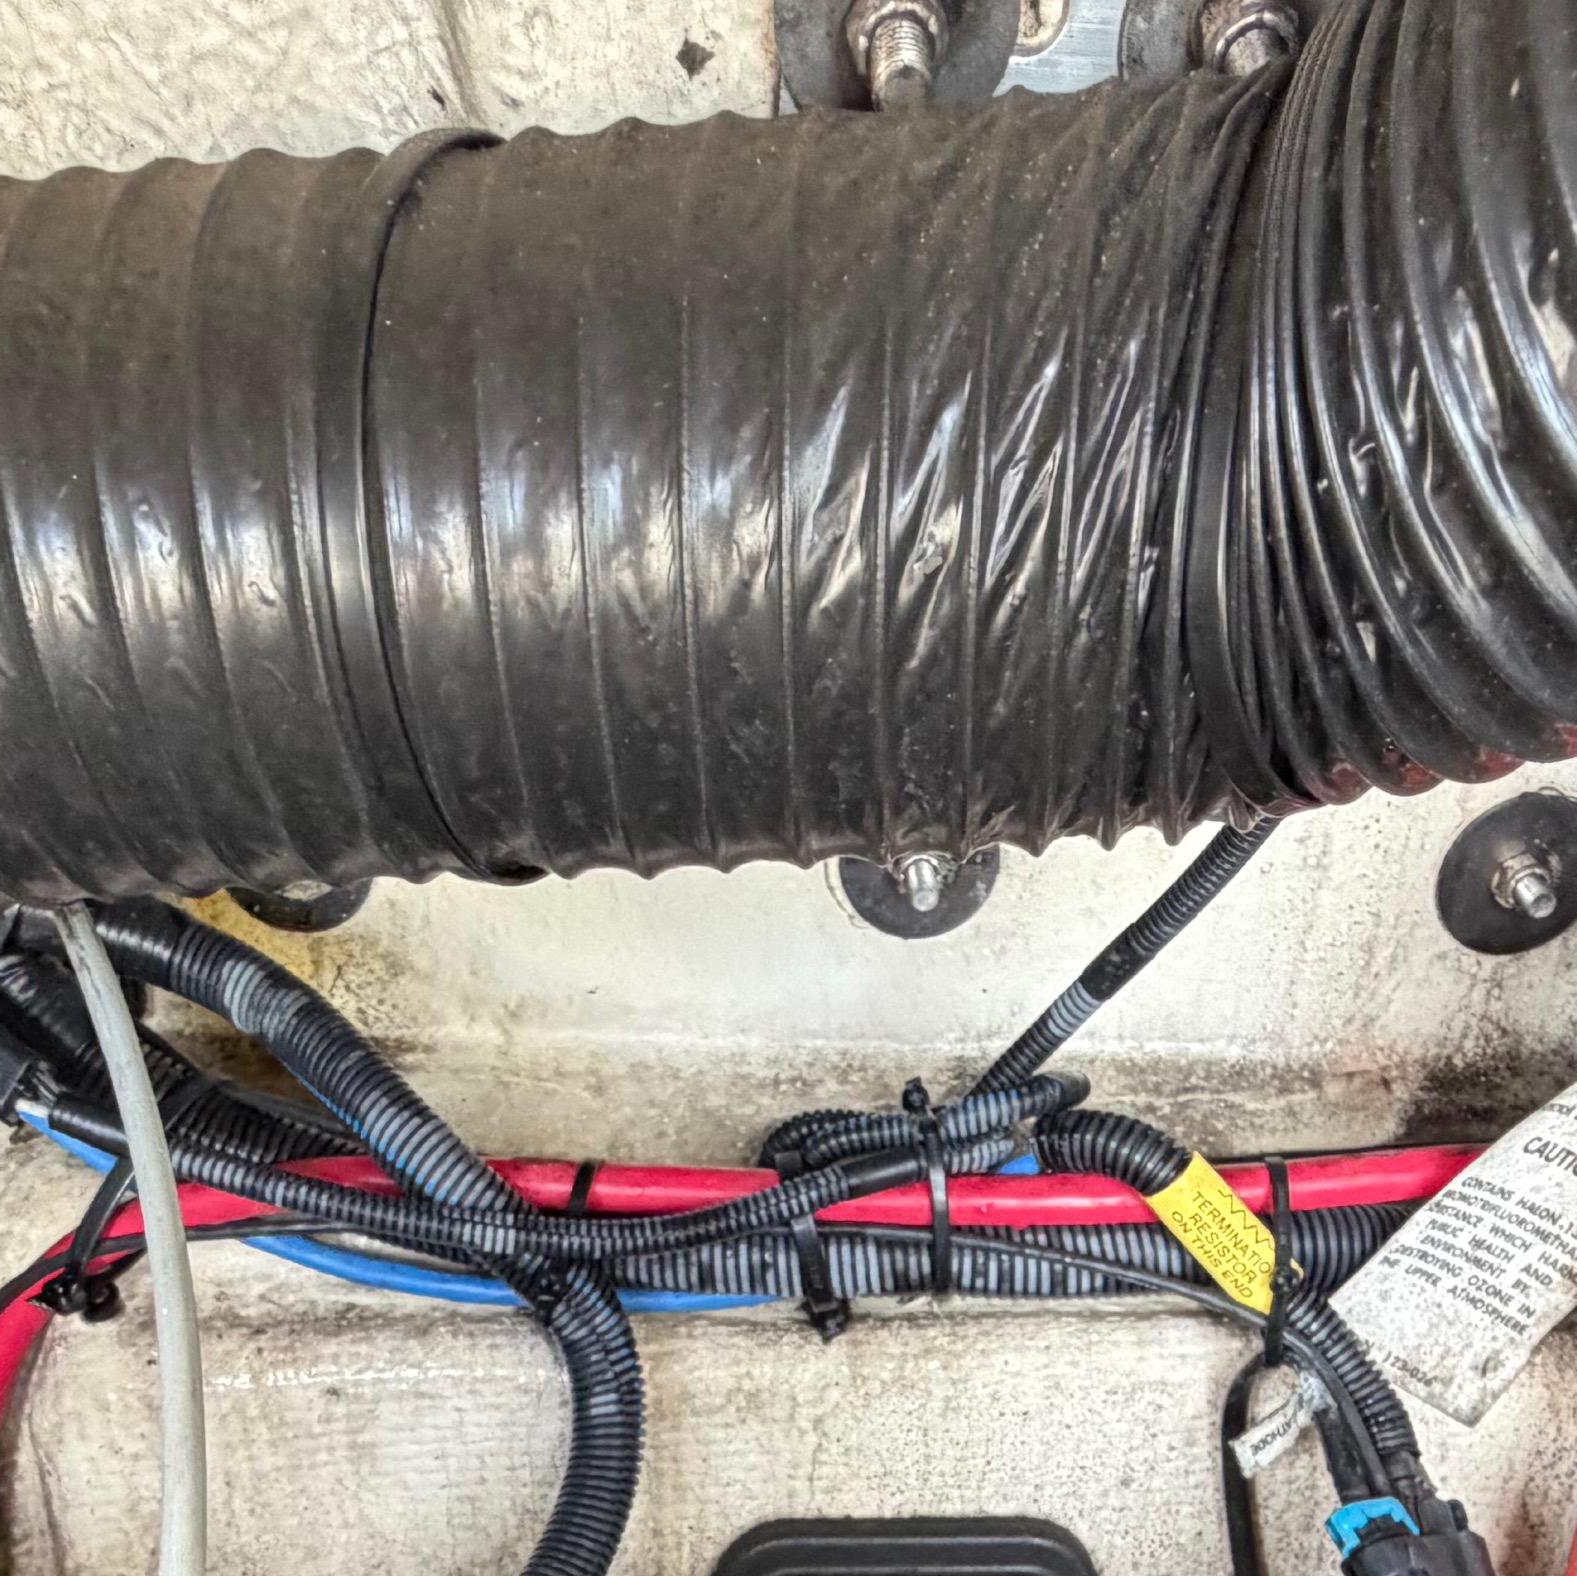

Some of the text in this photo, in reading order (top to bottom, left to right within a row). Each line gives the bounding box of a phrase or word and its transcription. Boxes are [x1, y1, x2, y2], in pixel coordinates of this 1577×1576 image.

[1190, 1190, 1273, 1276] TERMINATIO
[1514, 1196, 1561, 1227] HALON
[1169, 1209, 1255, 1300] ON THIS END
[1186, 1212, 1257, 1285] RESISTOR
[1466, 1233, 1515, 1266] HEALTH
[1518, 1262, 1554, 1289] AND
[1486, 1222, 1533, 1255] WHICH
[1403, 1259, 1444, 1287] UPPER
[1465, 1272, 1516, 1308] OZONE
[1515, 1301, 1537, 1321] IN
